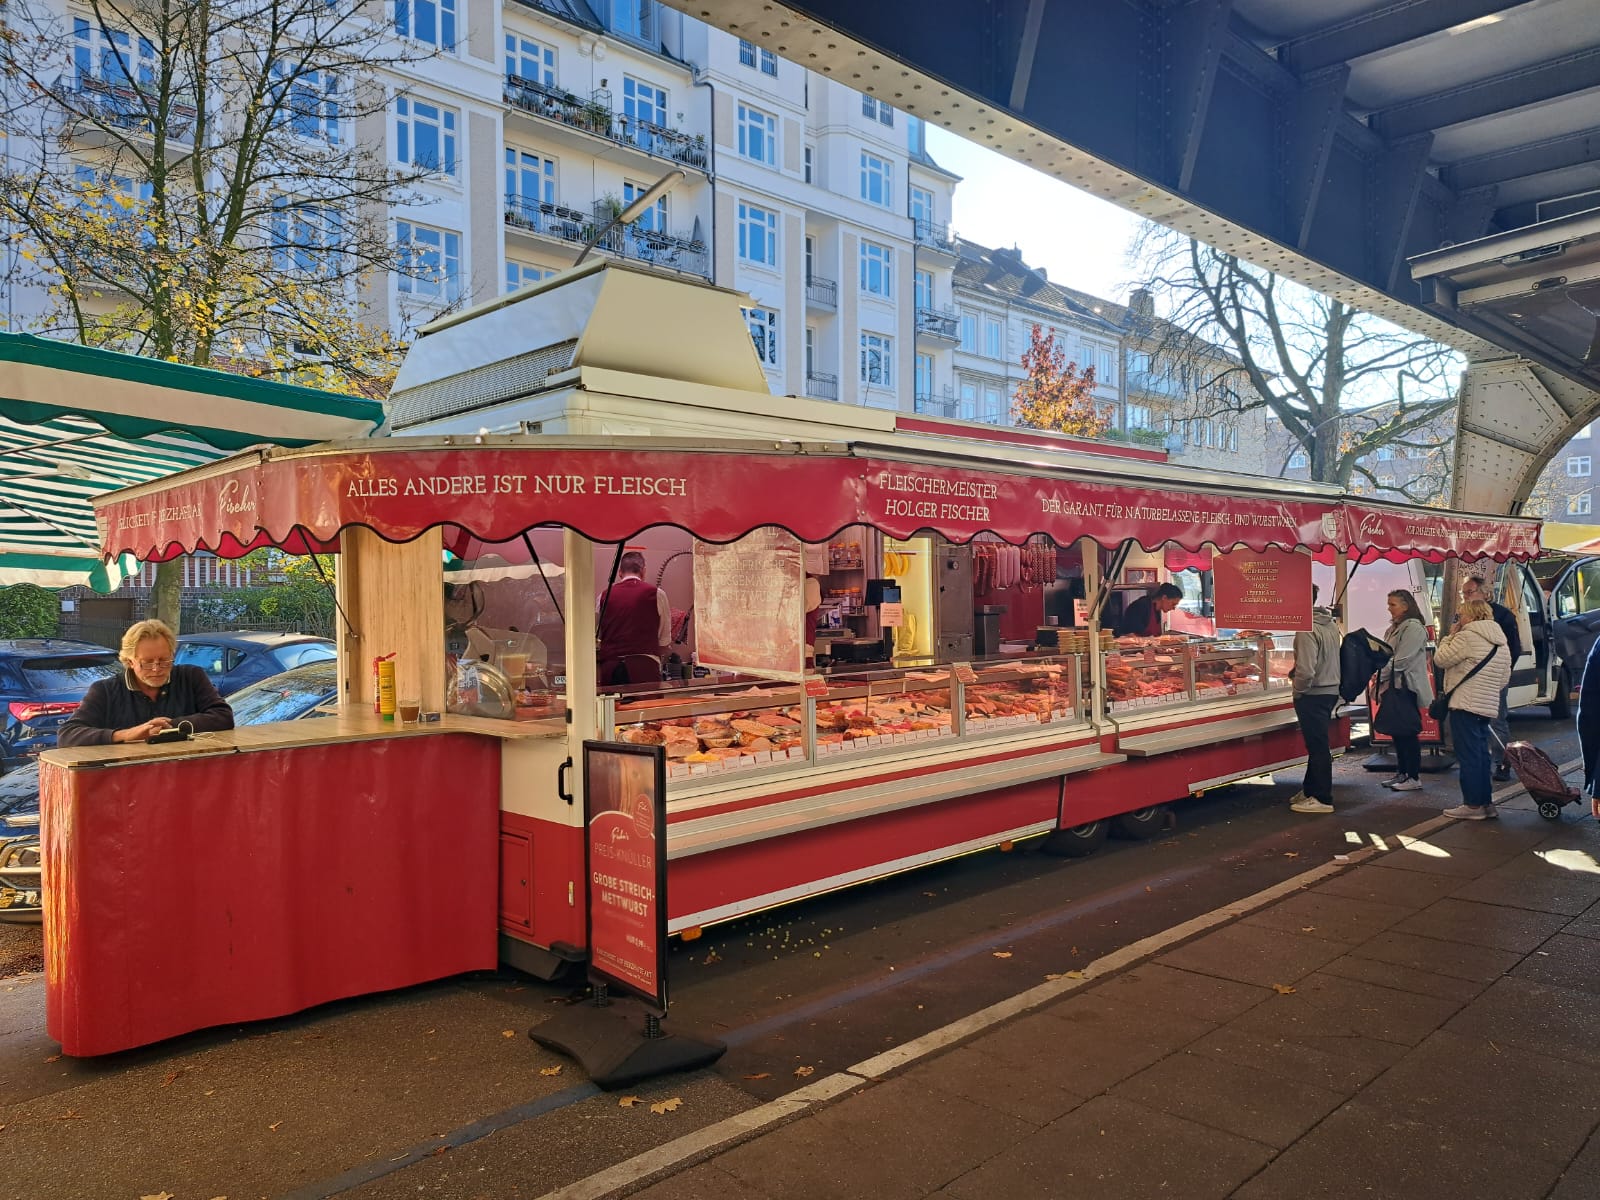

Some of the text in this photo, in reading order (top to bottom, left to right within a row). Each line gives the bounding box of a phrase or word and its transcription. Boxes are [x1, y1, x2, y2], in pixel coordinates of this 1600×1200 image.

[347, 475, 687, 497] ALLES ANDERE IST NUR FLEISCH
[879, 473, 998, 499] FLEISCHERMEISTER
[885, 499, 991, 521] HOLGER FISCHER
[1042, 498, 1061, 513] DER
[1063, 500, 1104, 517] GARANT
[1105, 502, 1122, 519] FÜR
[1124, 506, 1200, 524] NATURBELASSENE
[1234, 513, 1250, 526] UND
[593, 871, 617, 890] GROBE
[619, 879, 656, 902] STREICH-
[601, 889, 648, 917] METTWURST
